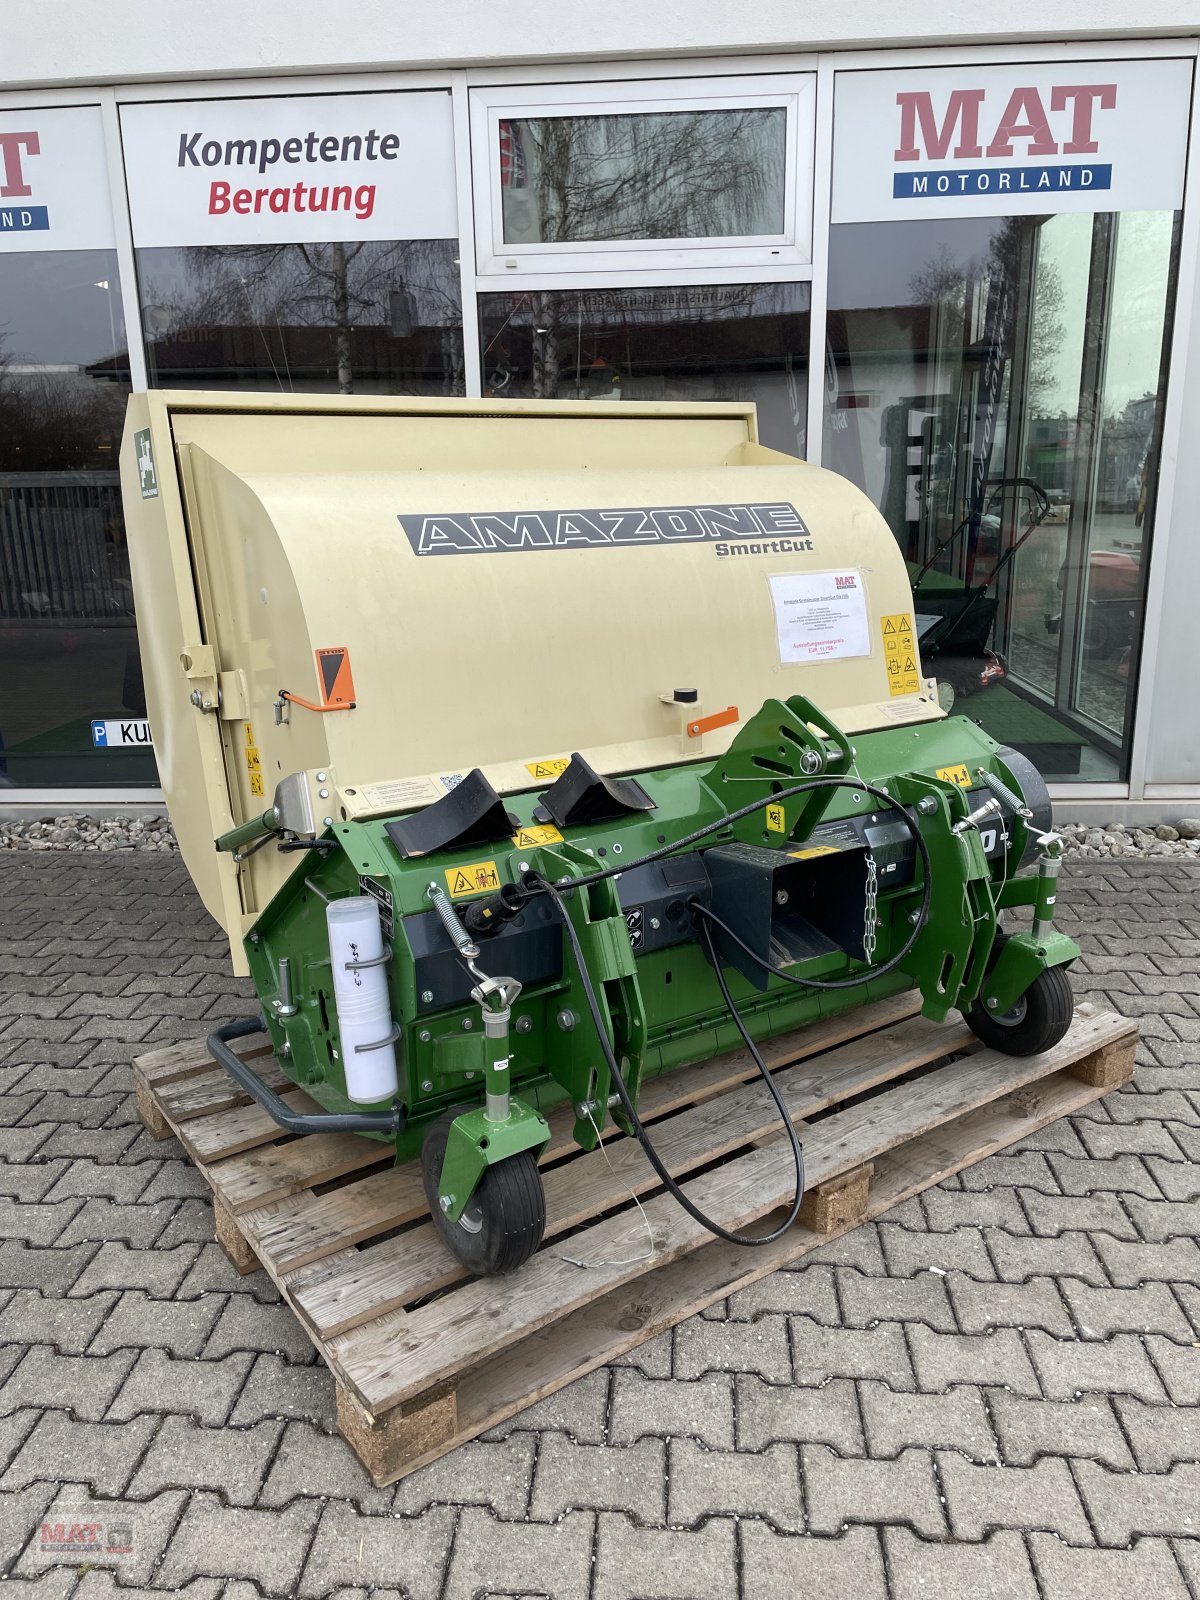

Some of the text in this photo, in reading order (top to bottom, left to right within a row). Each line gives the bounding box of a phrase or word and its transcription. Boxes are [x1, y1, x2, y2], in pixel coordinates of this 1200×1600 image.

[894, 84, 1118, 162] MAT
[178, 129, 400, 174] Kompetente
[912, 168, 1094, 193] MOTORLAND
[208, 181, 377, 220] Beratung
[418, 506, 806, 551] AMAZONE
[715, 539, 814, 557] SmartCut
[835, 576, 855, 586] MAT
[94, 726, 106, 742] P
